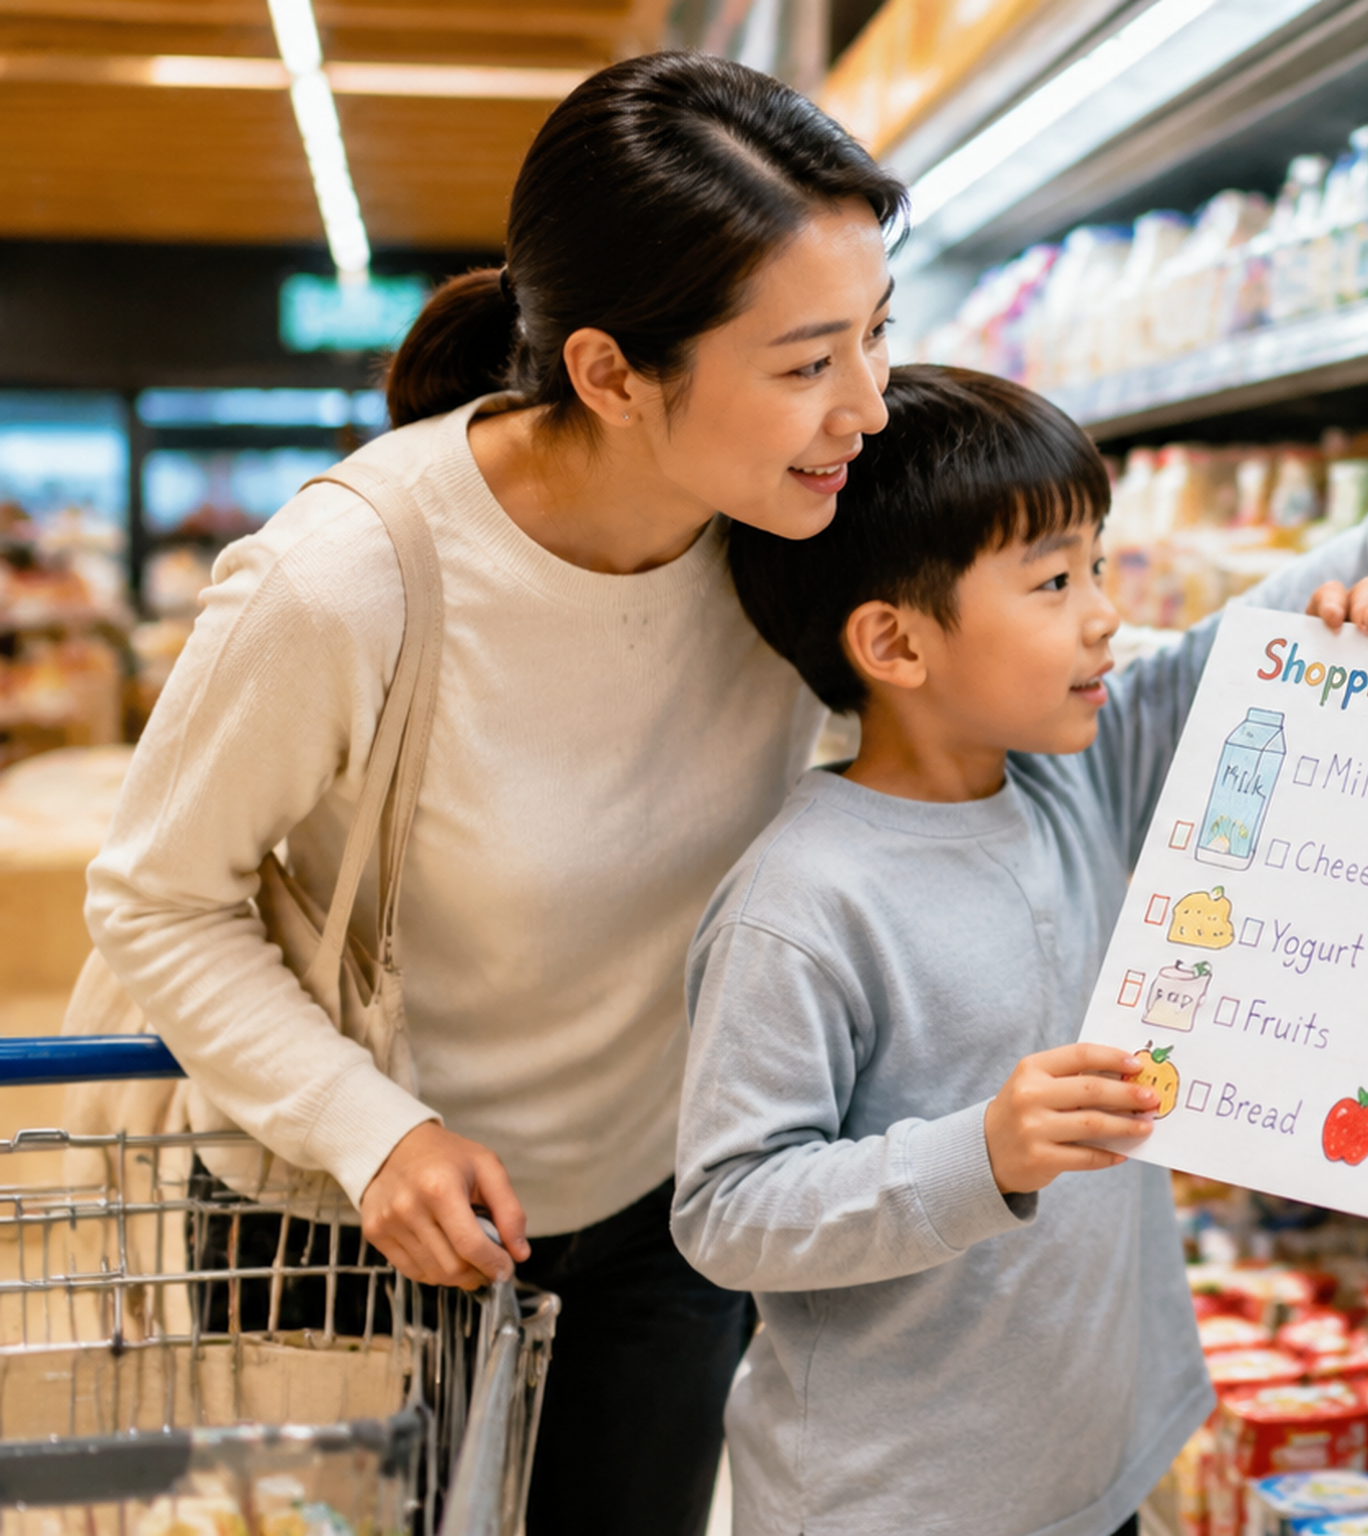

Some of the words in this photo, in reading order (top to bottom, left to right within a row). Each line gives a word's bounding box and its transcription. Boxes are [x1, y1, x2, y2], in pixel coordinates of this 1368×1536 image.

[1271, 920, 1365, 974] Yogurt
[1243, 999, 1330, 1050] Fruits
[1215, 1082, 1303, 1136] Bread
